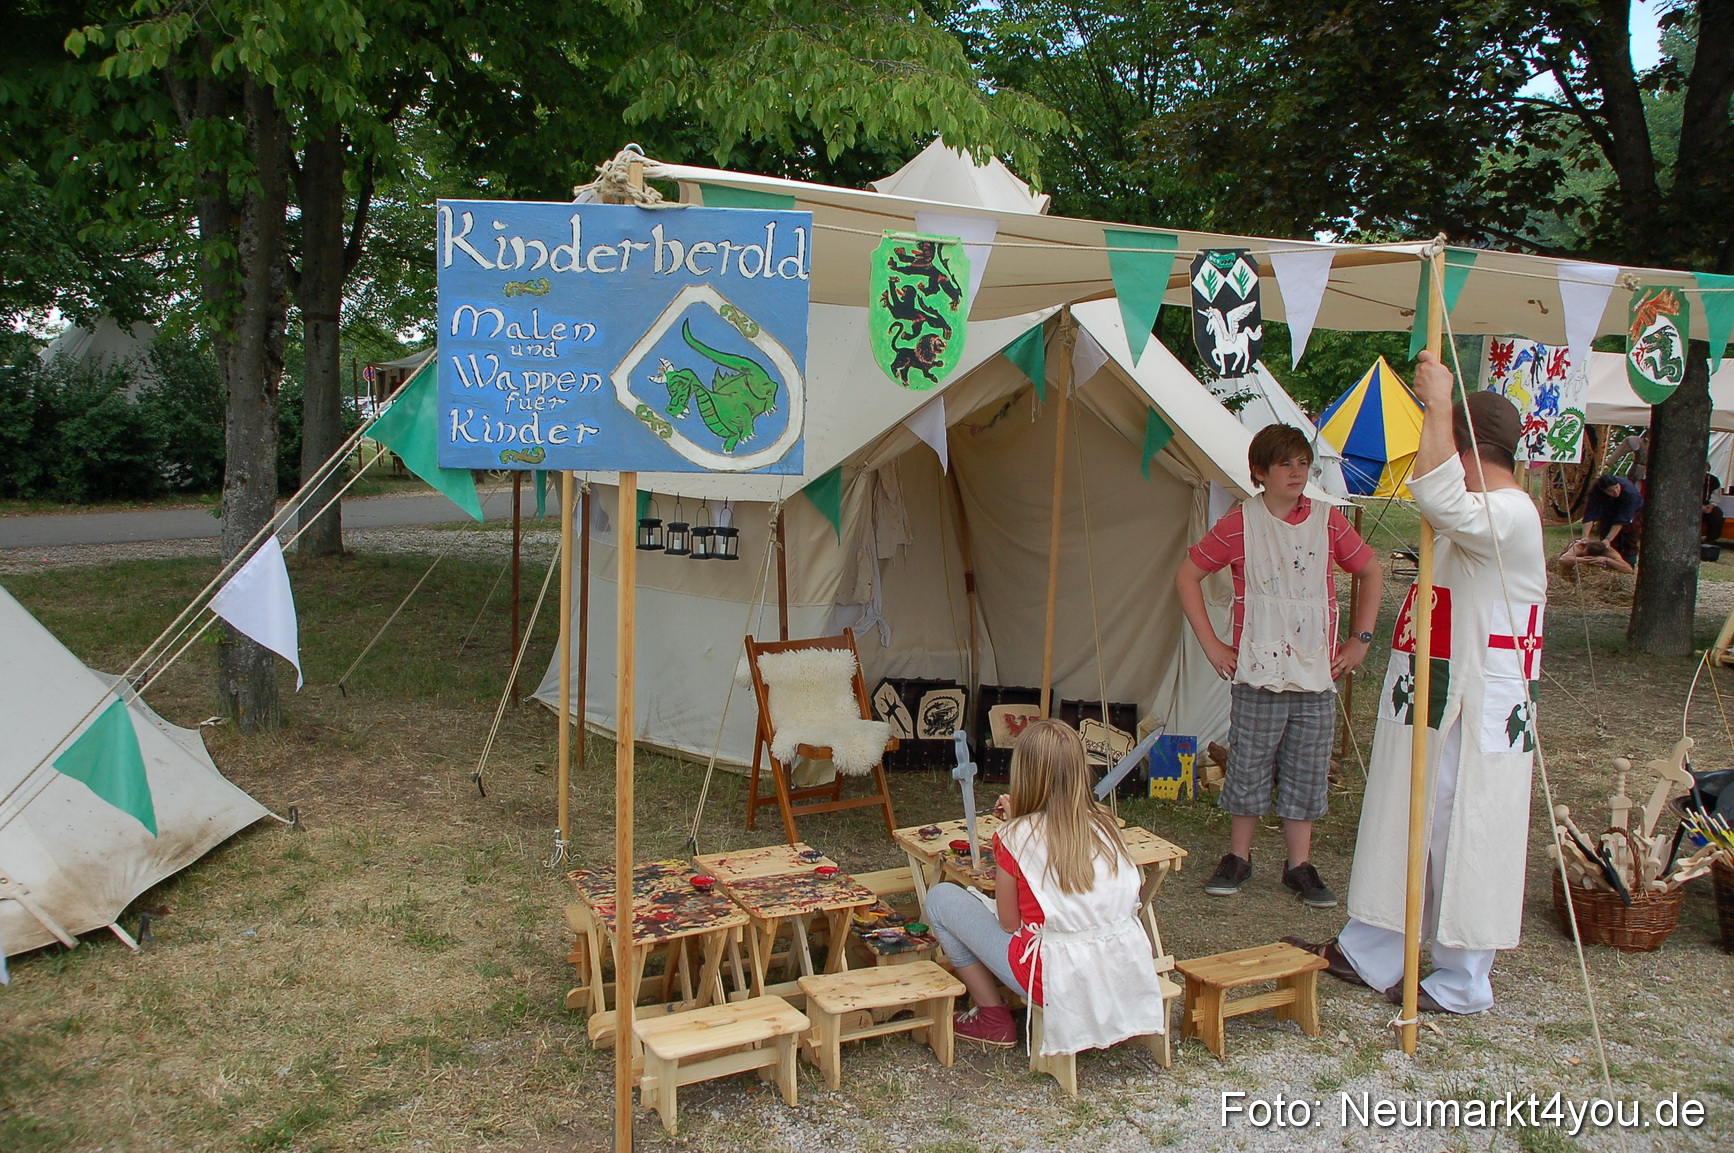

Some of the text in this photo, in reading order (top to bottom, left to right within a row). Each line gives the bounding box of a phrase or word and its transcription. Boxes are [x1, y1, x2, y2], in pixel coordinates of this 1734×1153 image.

[438, 206, 811, 281] Kinderherold
[450, 304, 597, 342] Malen
[510, 340, 558, 359] und
[451, 353, 602, 393] Wappen
[504, 391, 567, 413] fuer
[449, 408, 600, 445] Kinder
